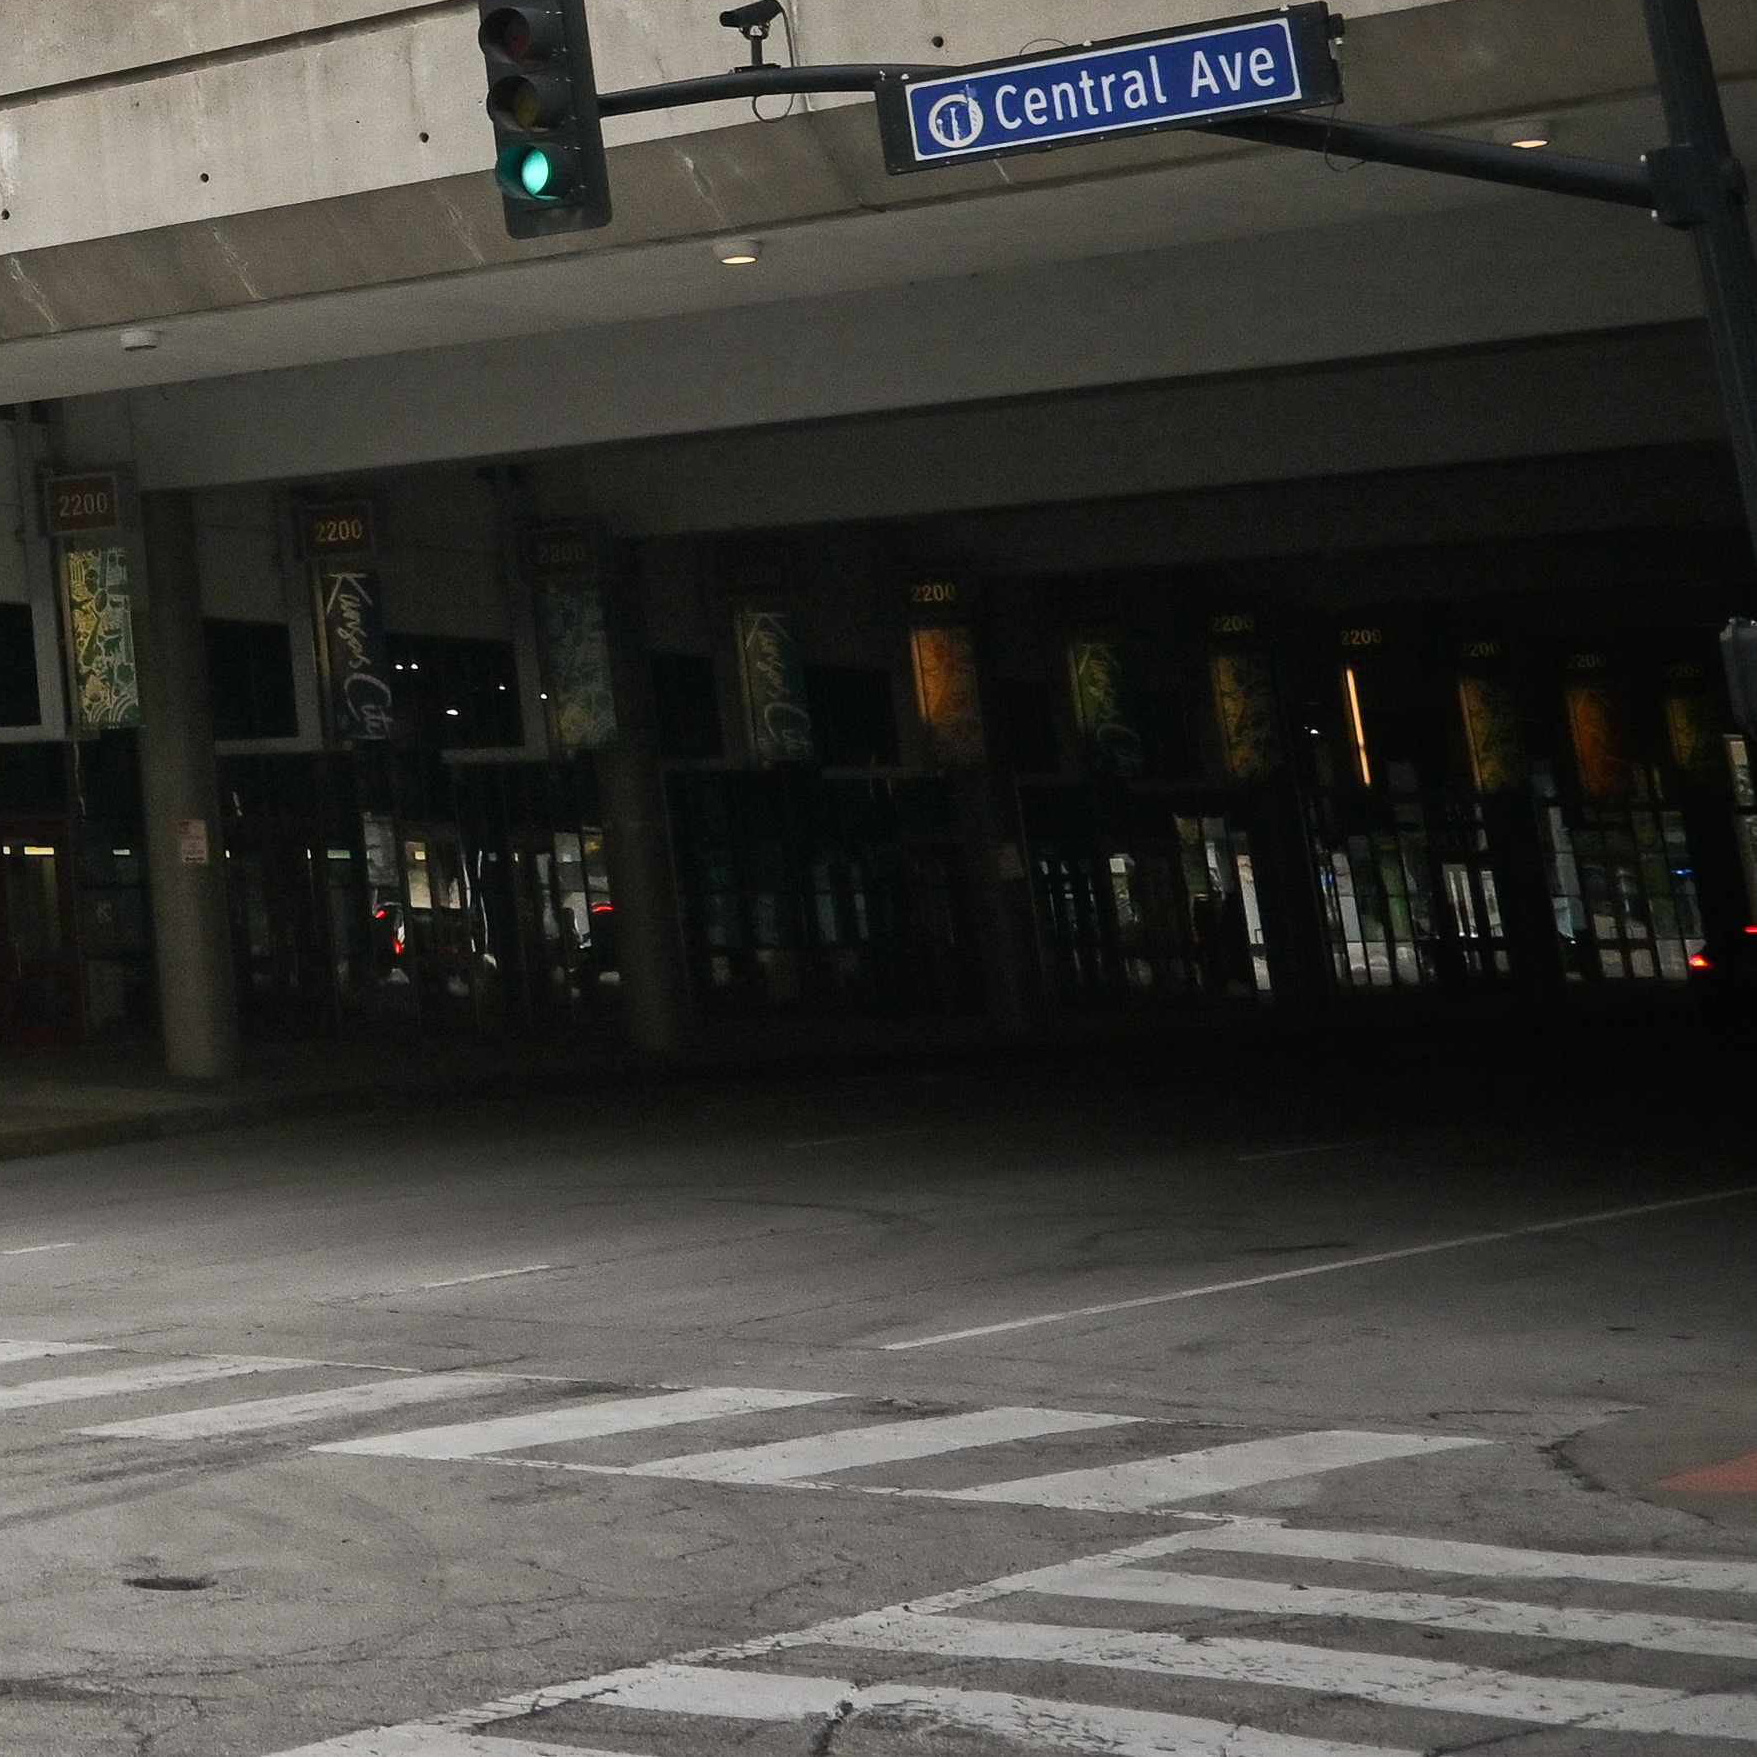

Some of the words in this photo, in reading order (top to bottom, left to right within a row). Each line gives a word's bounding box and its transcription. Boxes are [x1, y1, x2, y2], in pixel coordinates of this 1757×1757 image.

[994, 55, 1168, 130] Central
[1189, 45, 1276, 99] Ave
[58, 492, 108, 518] 2200
[314, 518, 364, 543] 2200
[911, 583, 956, 603] 2200
[1341, 628, 1383, 646] 2200
